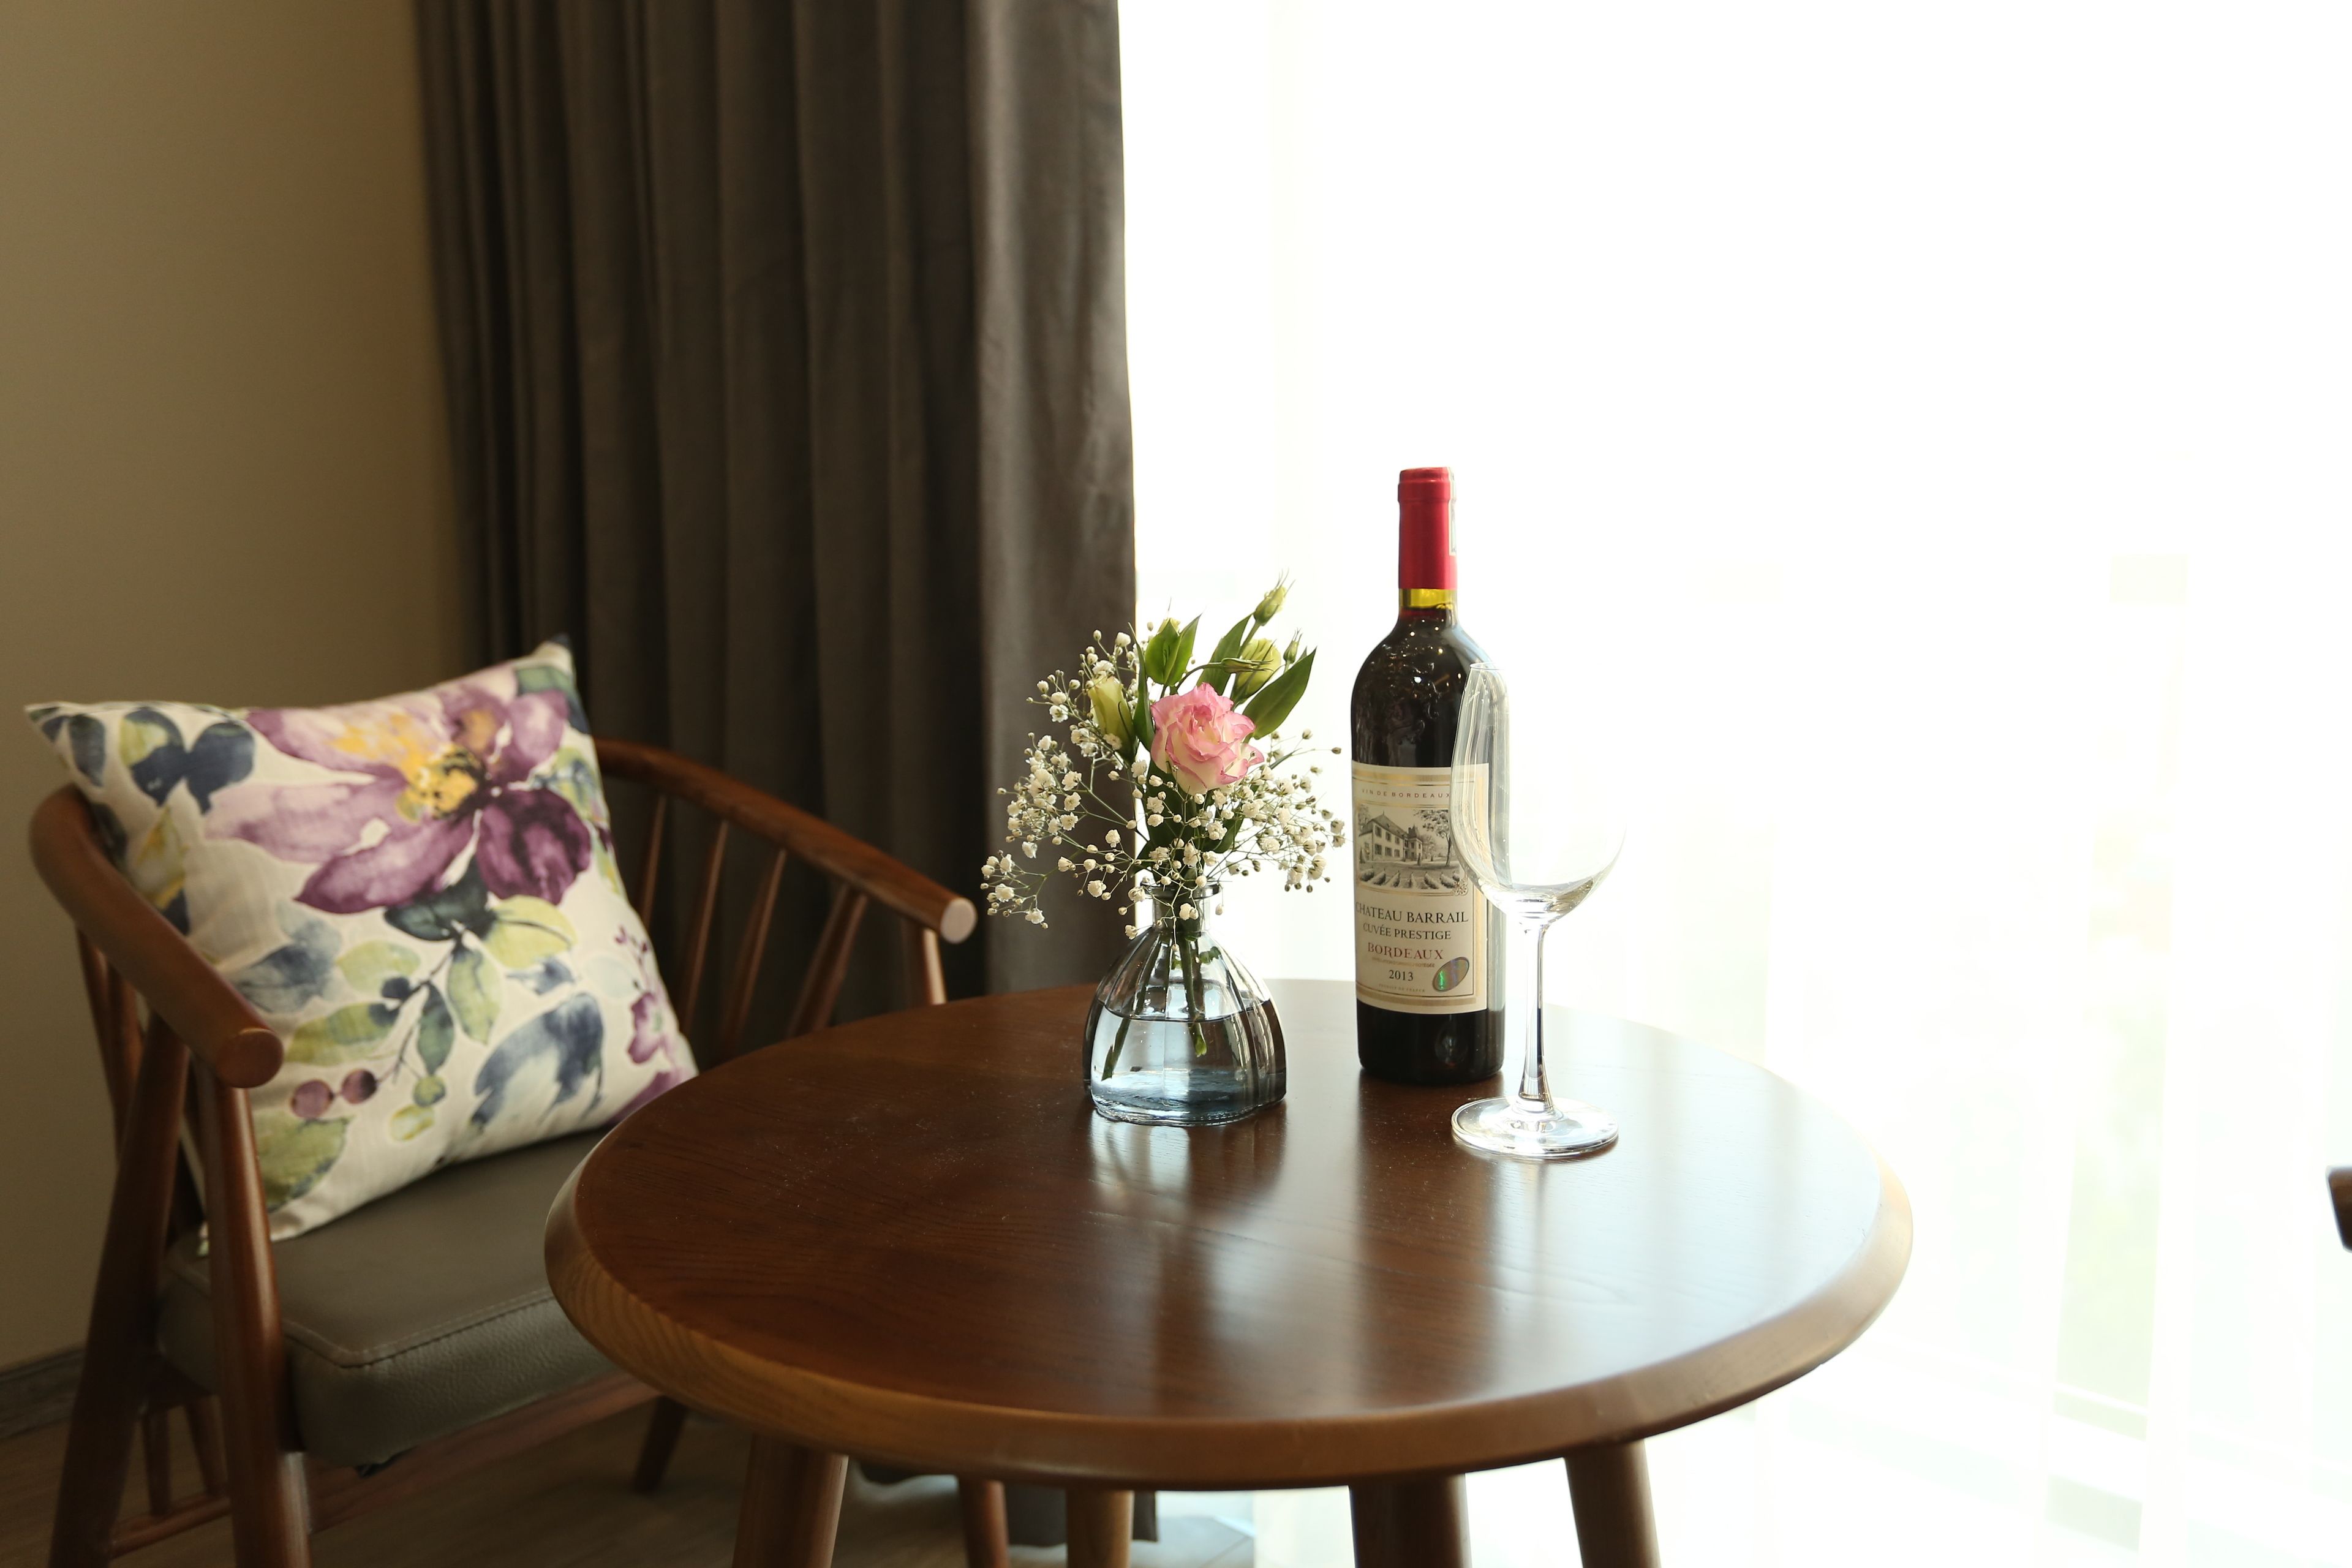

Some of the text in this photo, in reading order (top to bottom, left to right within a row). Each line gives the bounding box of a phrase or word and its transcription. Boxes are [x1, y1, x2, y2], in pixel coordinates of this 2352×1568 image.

[1355, 902, 1469, 924] CHATEAU BARRAIL
[1363, 922, 1452, 940] CUVÉE PRESTIGE
[1368, 942, 1443, 960] BORDEAUX
[1389, 970, 1414, 981] 2013
